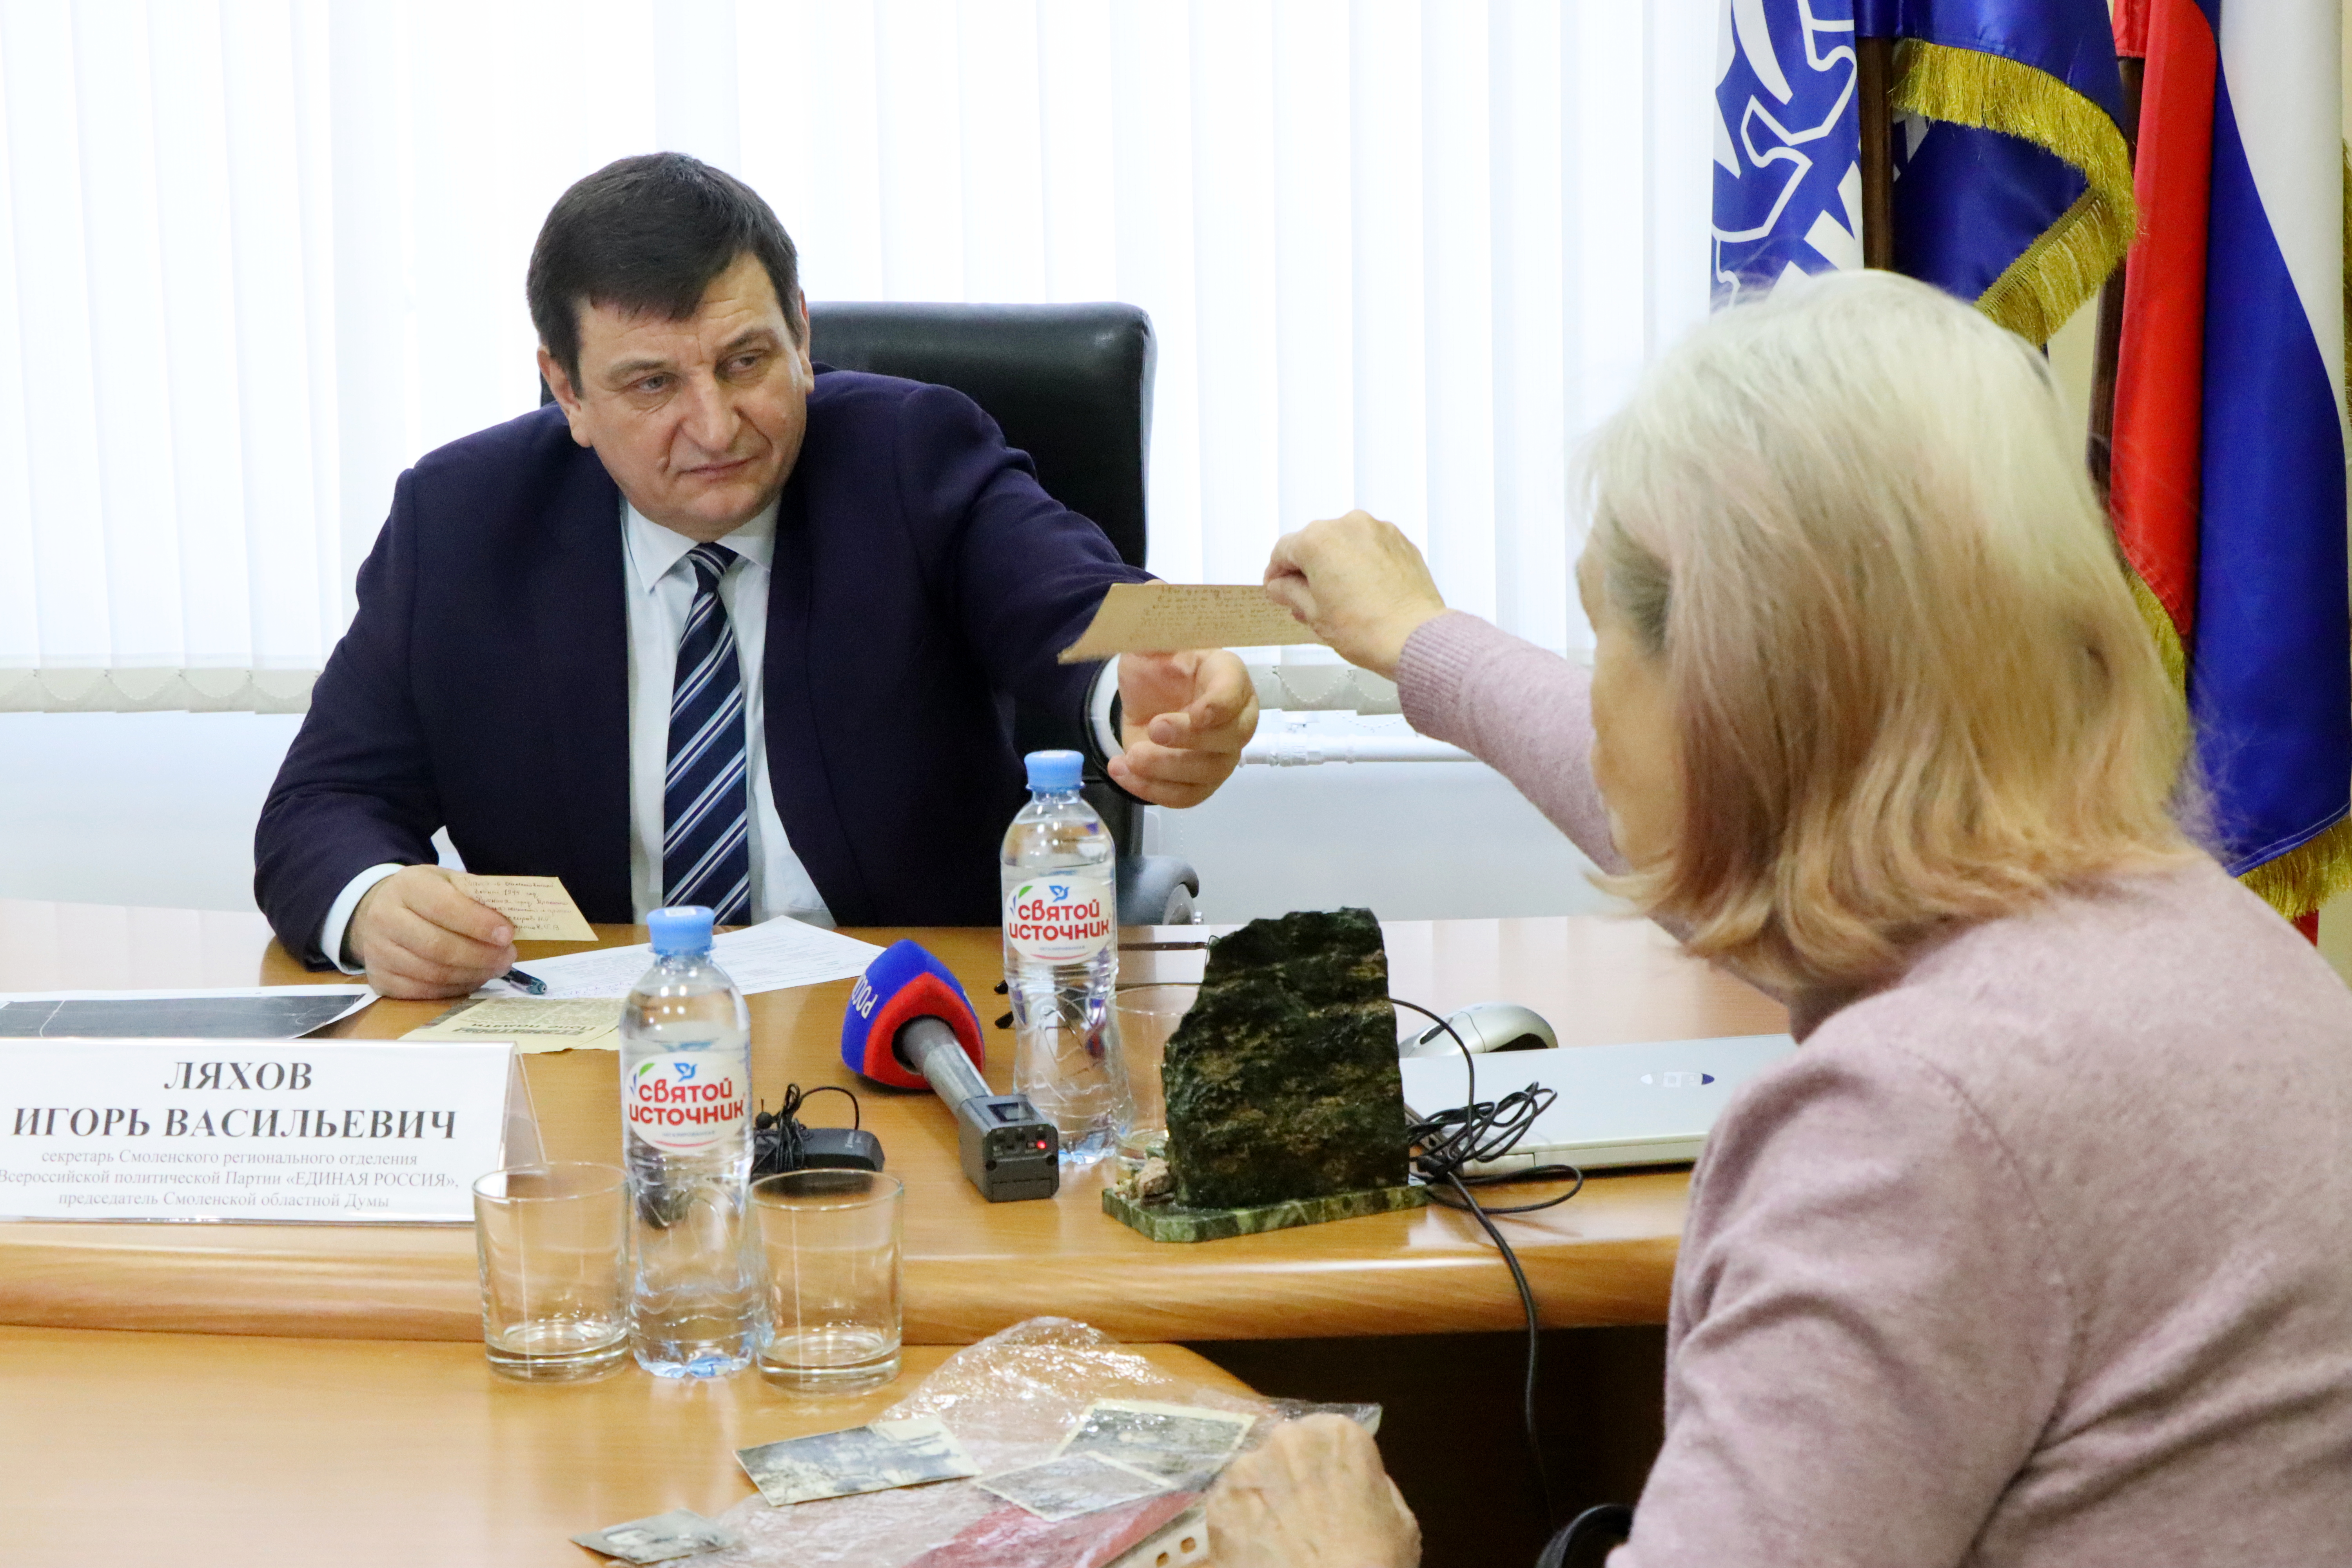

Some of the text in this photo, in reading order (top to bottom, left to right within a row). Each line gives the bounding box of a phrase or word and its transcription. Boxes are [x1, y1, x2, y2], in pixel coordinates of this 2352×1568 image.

[164, 1062, 312, 1090] ЛЯХОВ
[10, 1108, 459, 1139] ИГОРЬ ВАСИЛЬЕВИЧ
[42, 1149, 418, 1167] секретарь Смоленского регионального отделения
[0, 1169, 459, 1189] Всероссийской политической Партии «ЕДИНАЯ РОССИЯ»,
[58, 1191, 389, 1210] председатель Смоленской областной Думы
